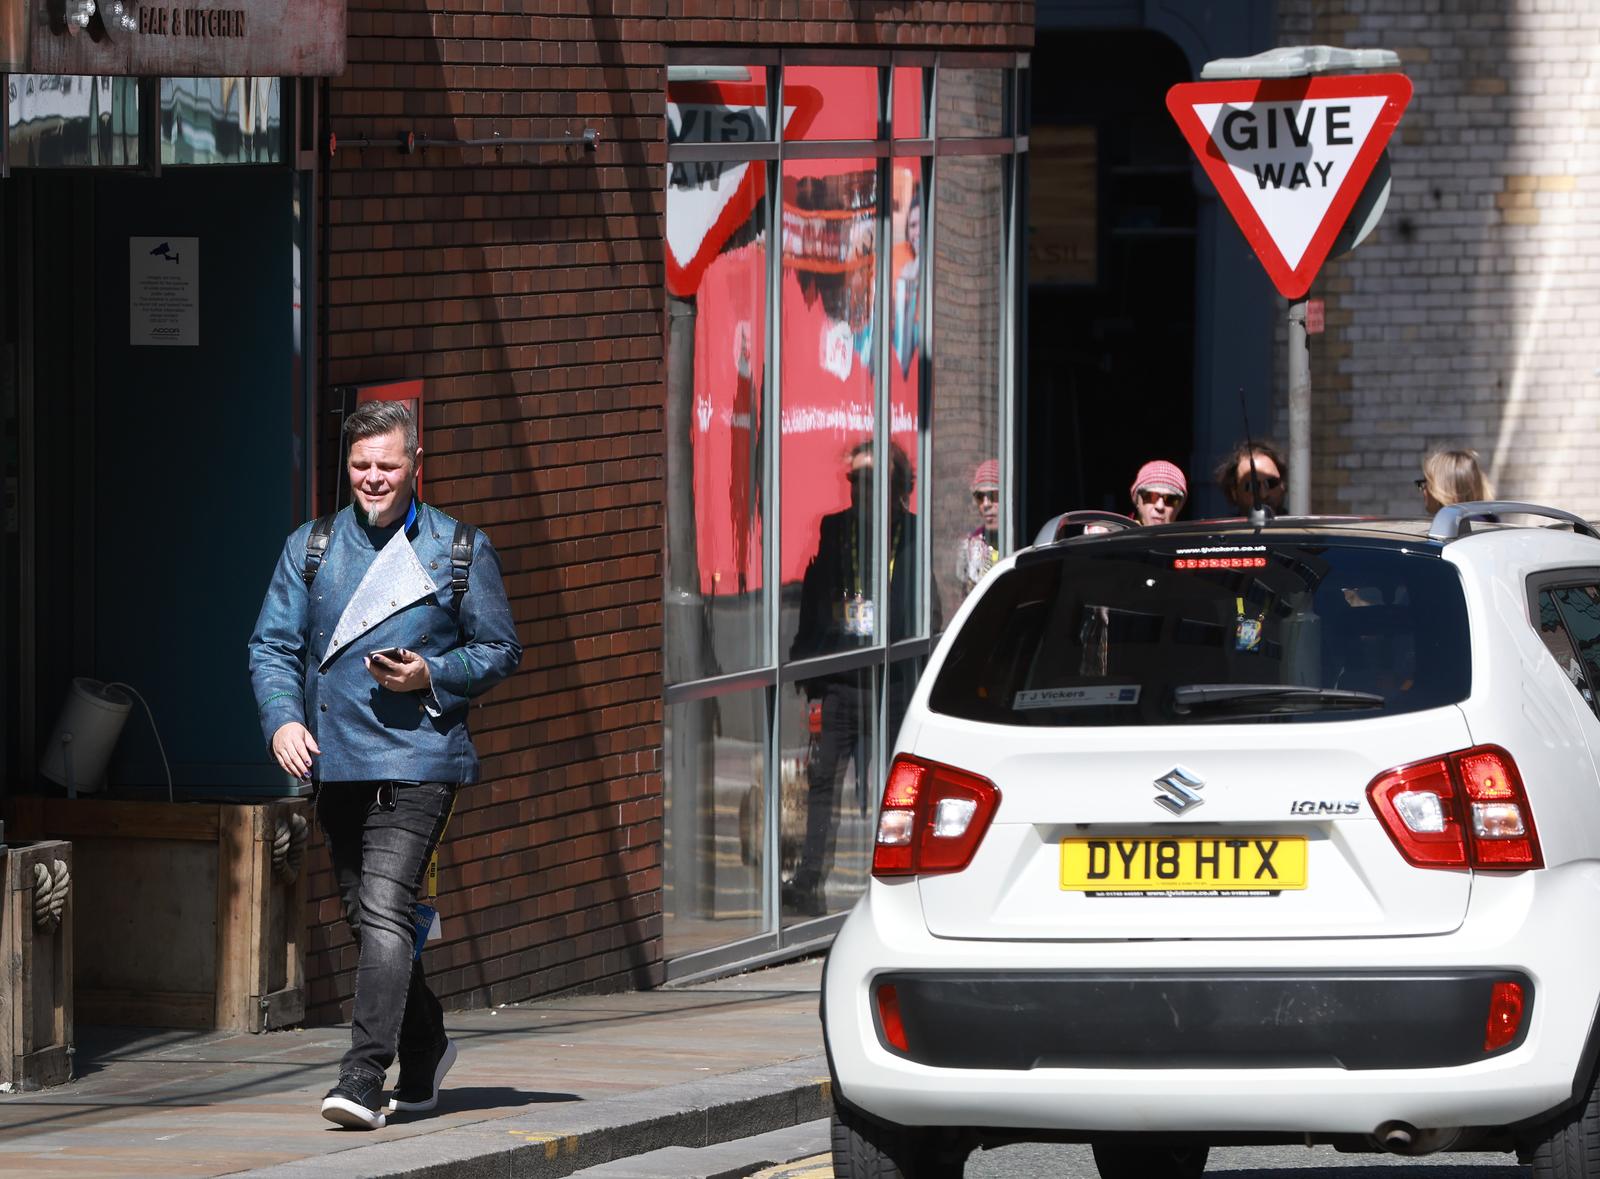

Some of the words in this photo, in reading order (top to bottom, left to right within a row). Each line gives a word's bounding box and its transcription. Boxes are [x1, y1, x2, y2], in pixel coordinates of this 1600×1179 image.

[139, 7, 169, 35] BAR
[172, 8, 181, 35] &
[185, 9, 246, 37] KITCHEN
[1222, 105, 1353, 151] GIVE
[1254, 161, 1334, 190] WAY
[1176, 545, 1266, 554] www.tjvickers.co.uk
[1020, 693, 1029, 701] T
[1030, 692, 1038, 700] J
[1041, 690, 1086, 700] Vickers
[1290, 800, 1361, 815] IGNIS
[1087, 840, 1180, 880] DY18
[1195, 840, 1279, 880] HTX
